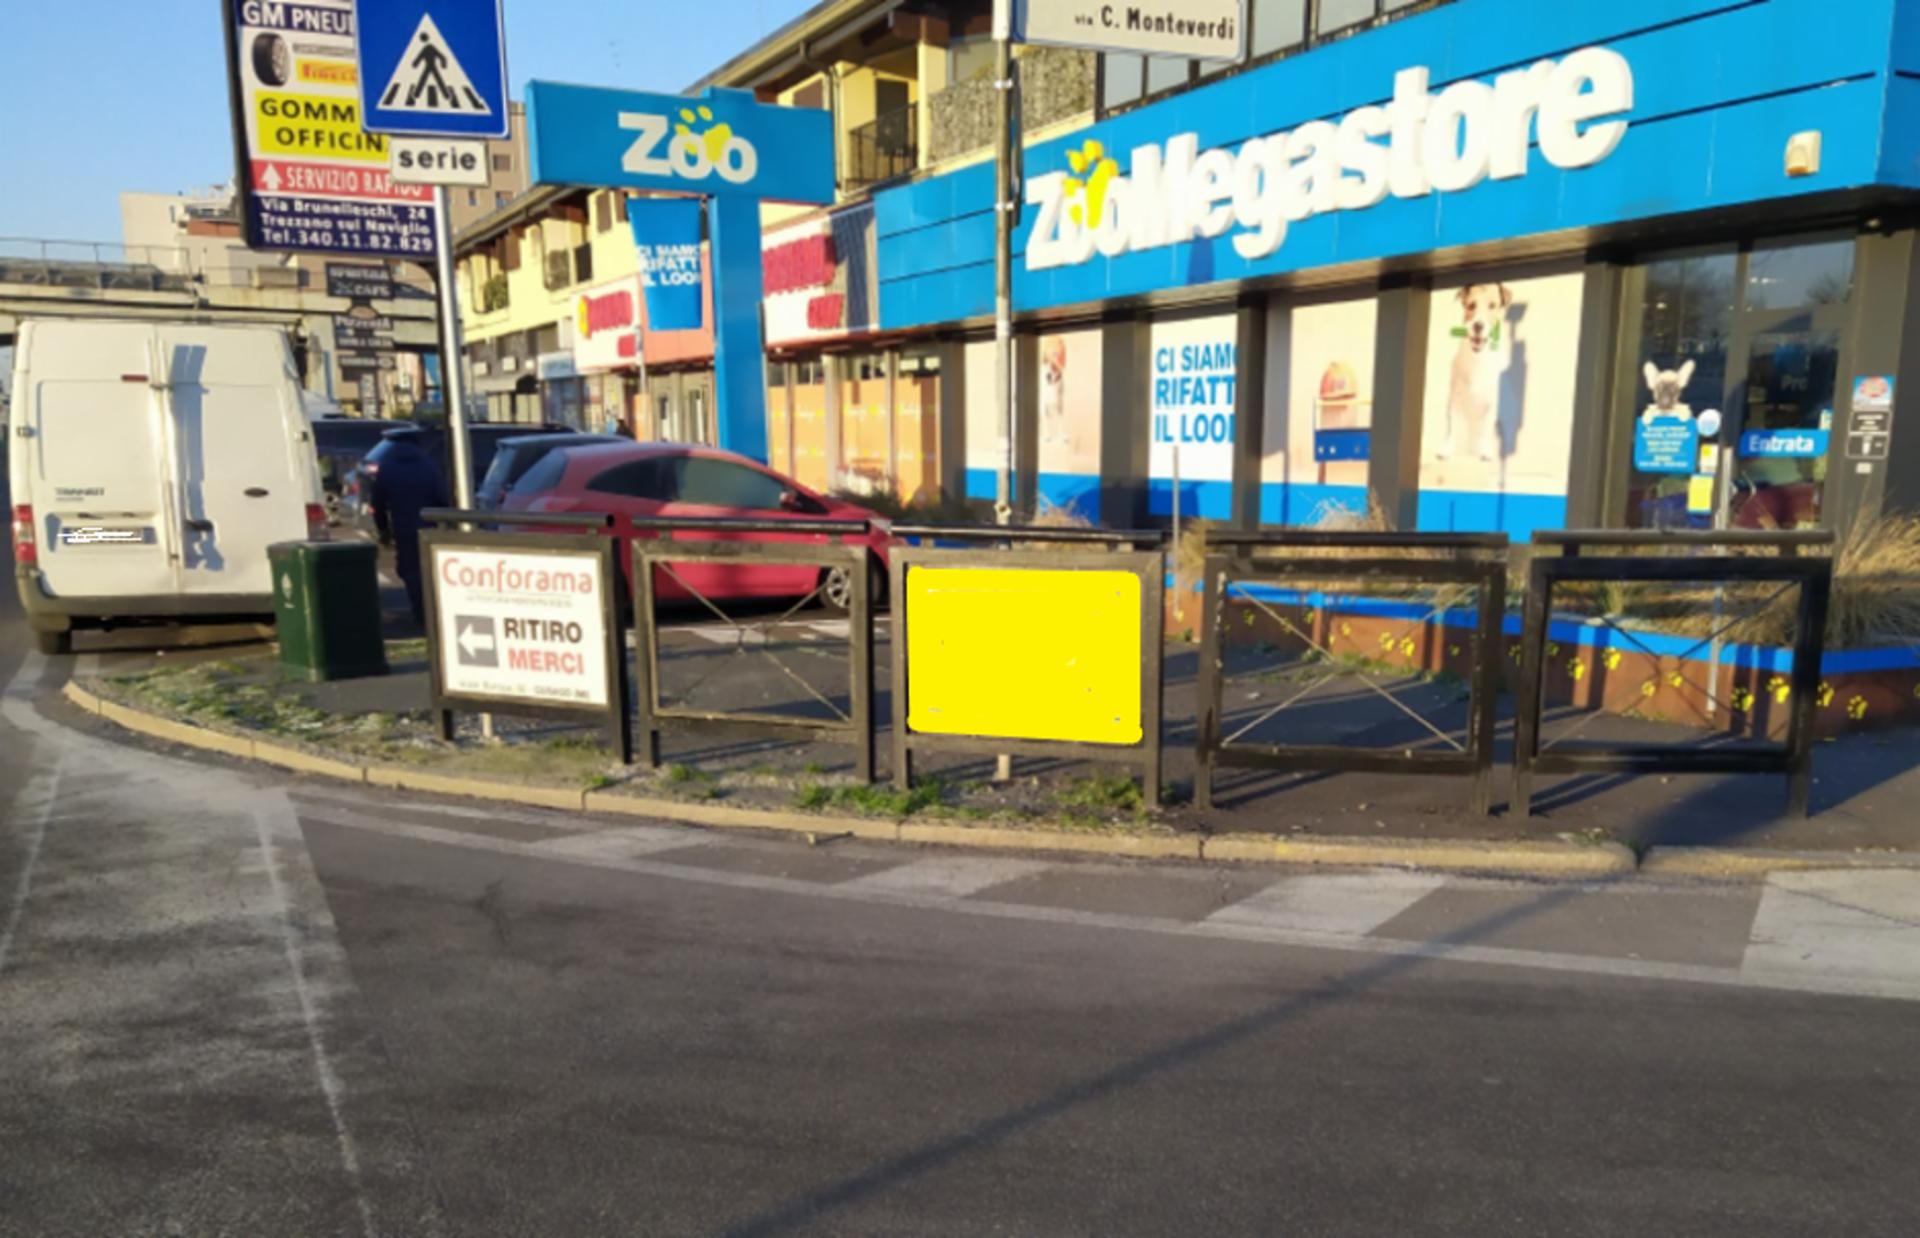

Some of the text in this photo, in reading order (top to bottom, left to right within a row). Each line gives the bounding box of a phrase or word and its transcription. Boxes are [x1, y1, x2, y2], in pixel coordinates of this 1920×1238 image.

[242, 0, 285, 27] GM
[1075, 5, 1234, 40] via C. Monteverdi
[398, 147, 478, 171] serie
[1025, 46, 1635, 271] ZooMegastore
[286, 167, 358, 193] SERVIZIO
[261, 199, 288, 212] Via
[408, 208, 427, 221] 24
[260, 213, 430, 236] Trezzano sul Naviglio
[1155, 347, 1175, 373] CI
[1155, 414, 1174, 443] IL
[1749, 435, 1815, 453] Entrata
[442, 558, 592, 594] Conforama
[503, 617, 582, 644] RITIRO
[507, 647, 584, 675] MERCI
